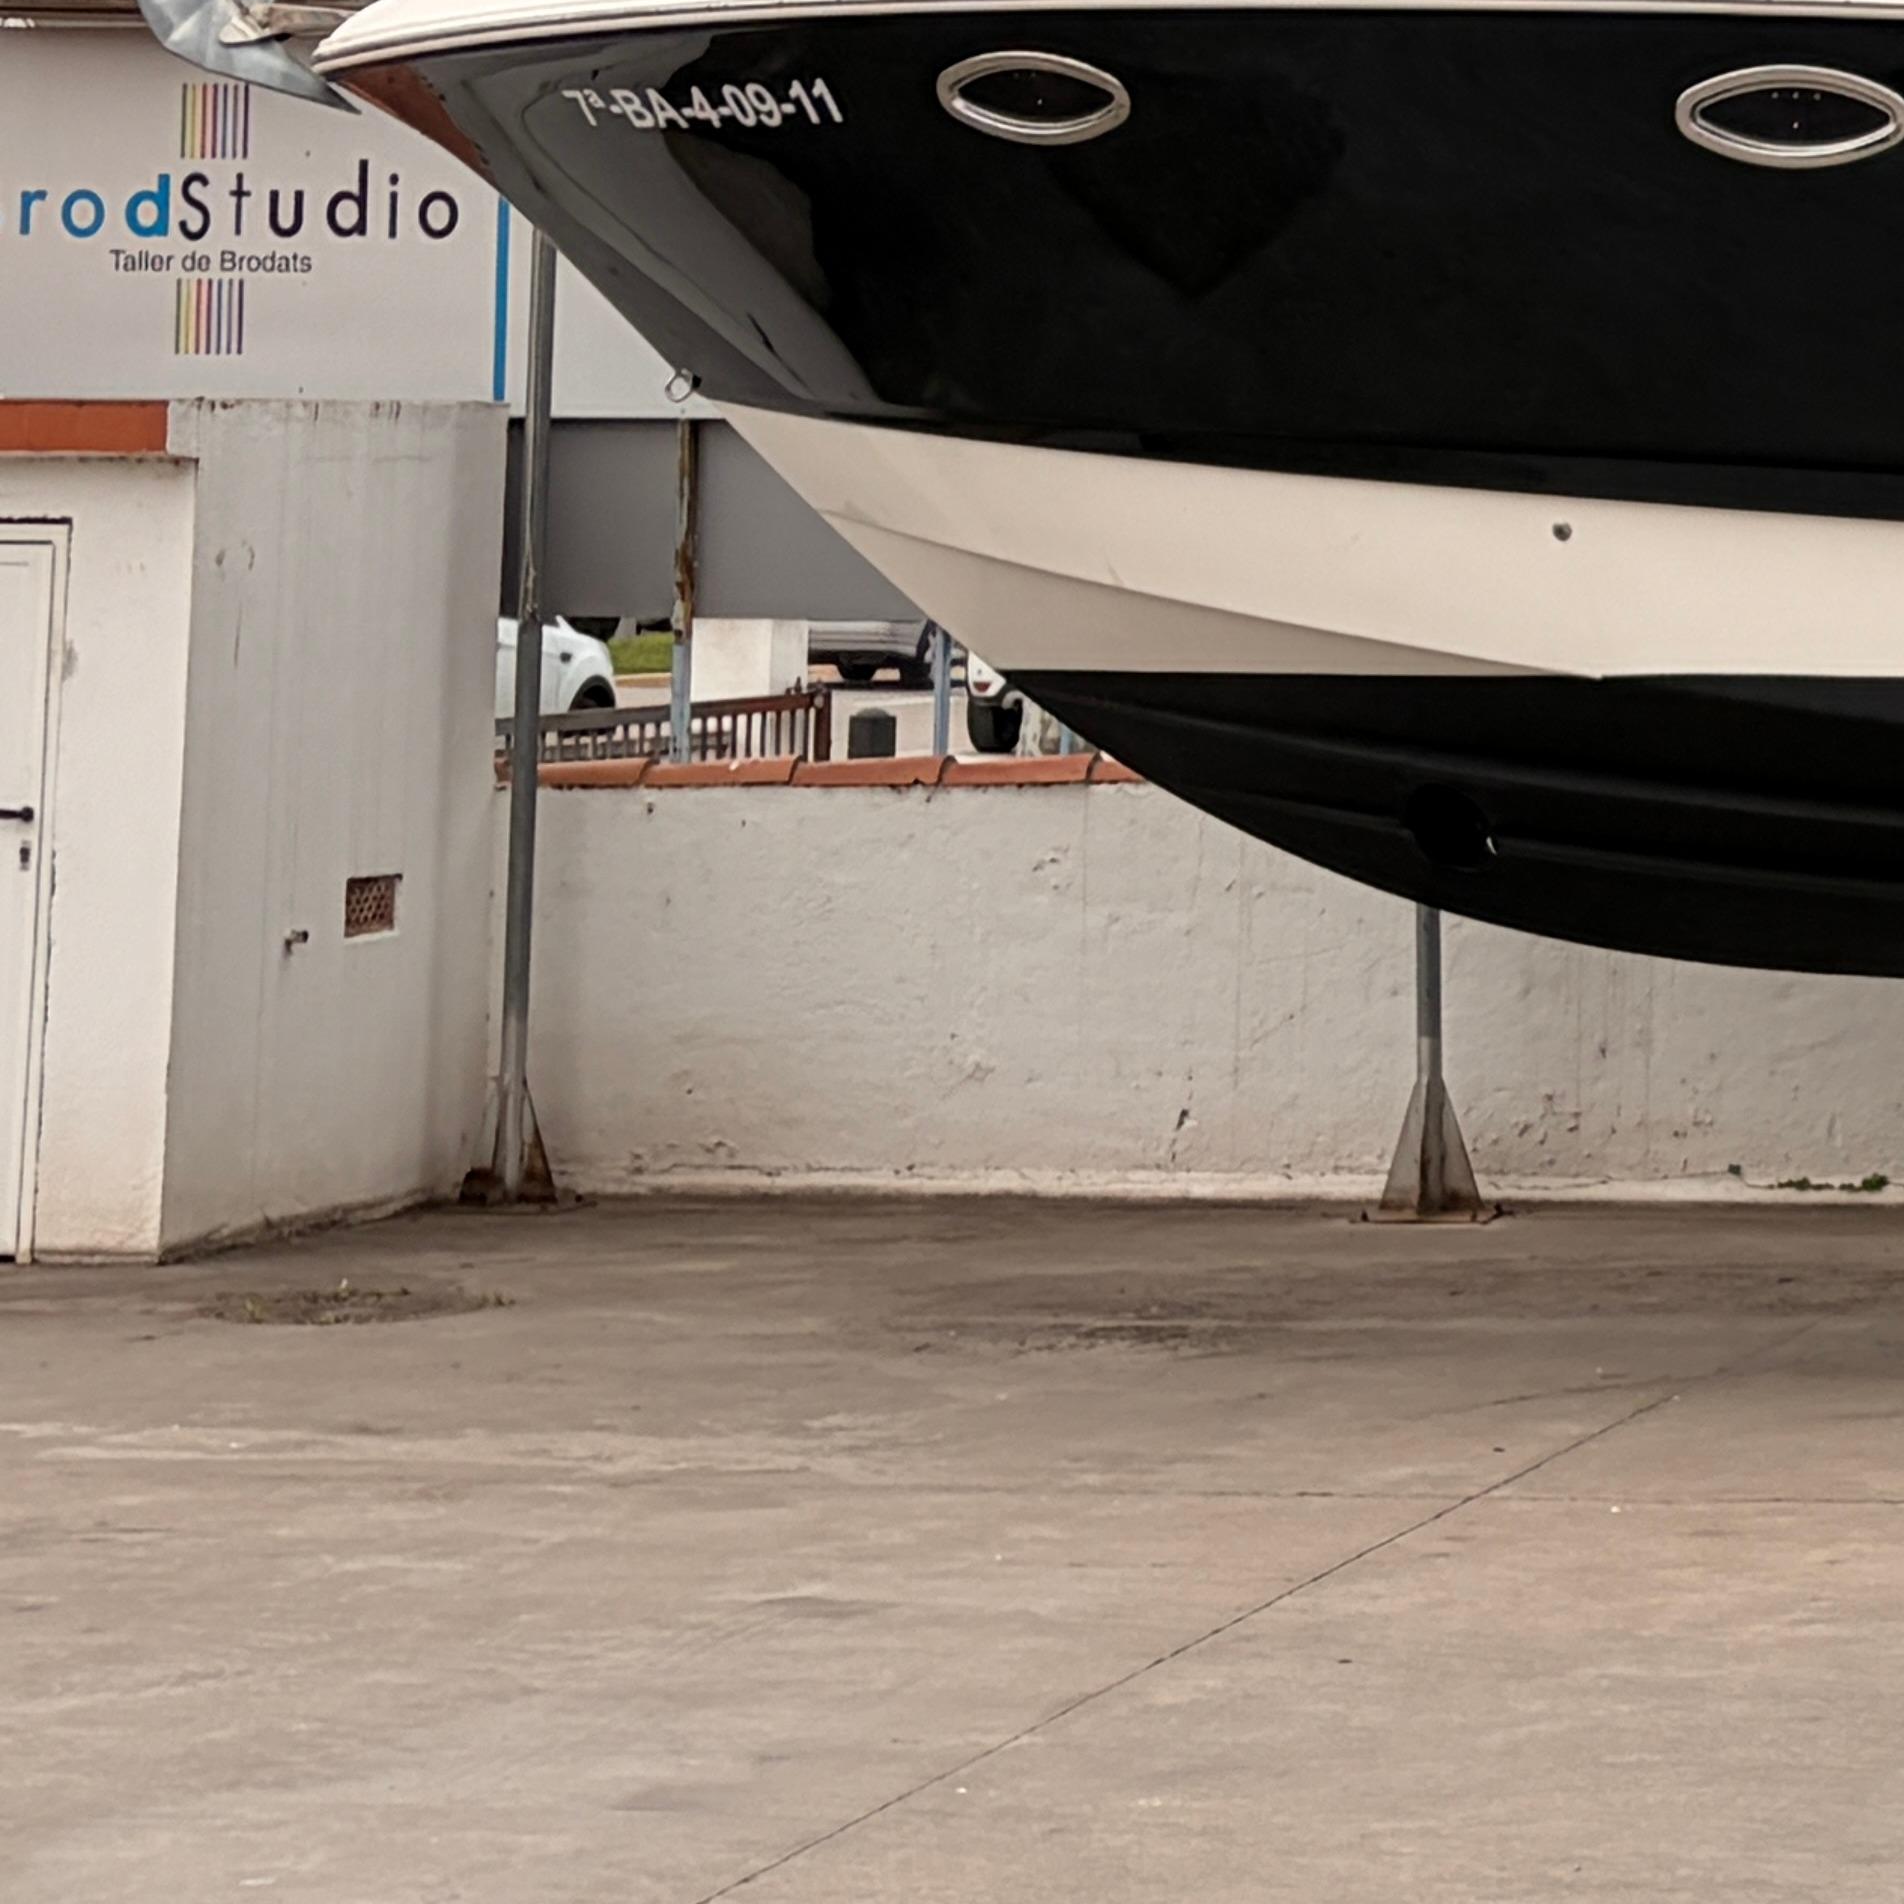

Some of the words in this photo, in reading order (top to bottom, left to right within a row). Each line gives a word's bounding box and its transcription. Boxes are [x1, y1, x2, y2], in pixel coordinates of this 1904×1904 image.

[110, 248, 174, 273] Taller
[181, 248, 210, 273] de
[218, 248, 313, 274] Brodats
